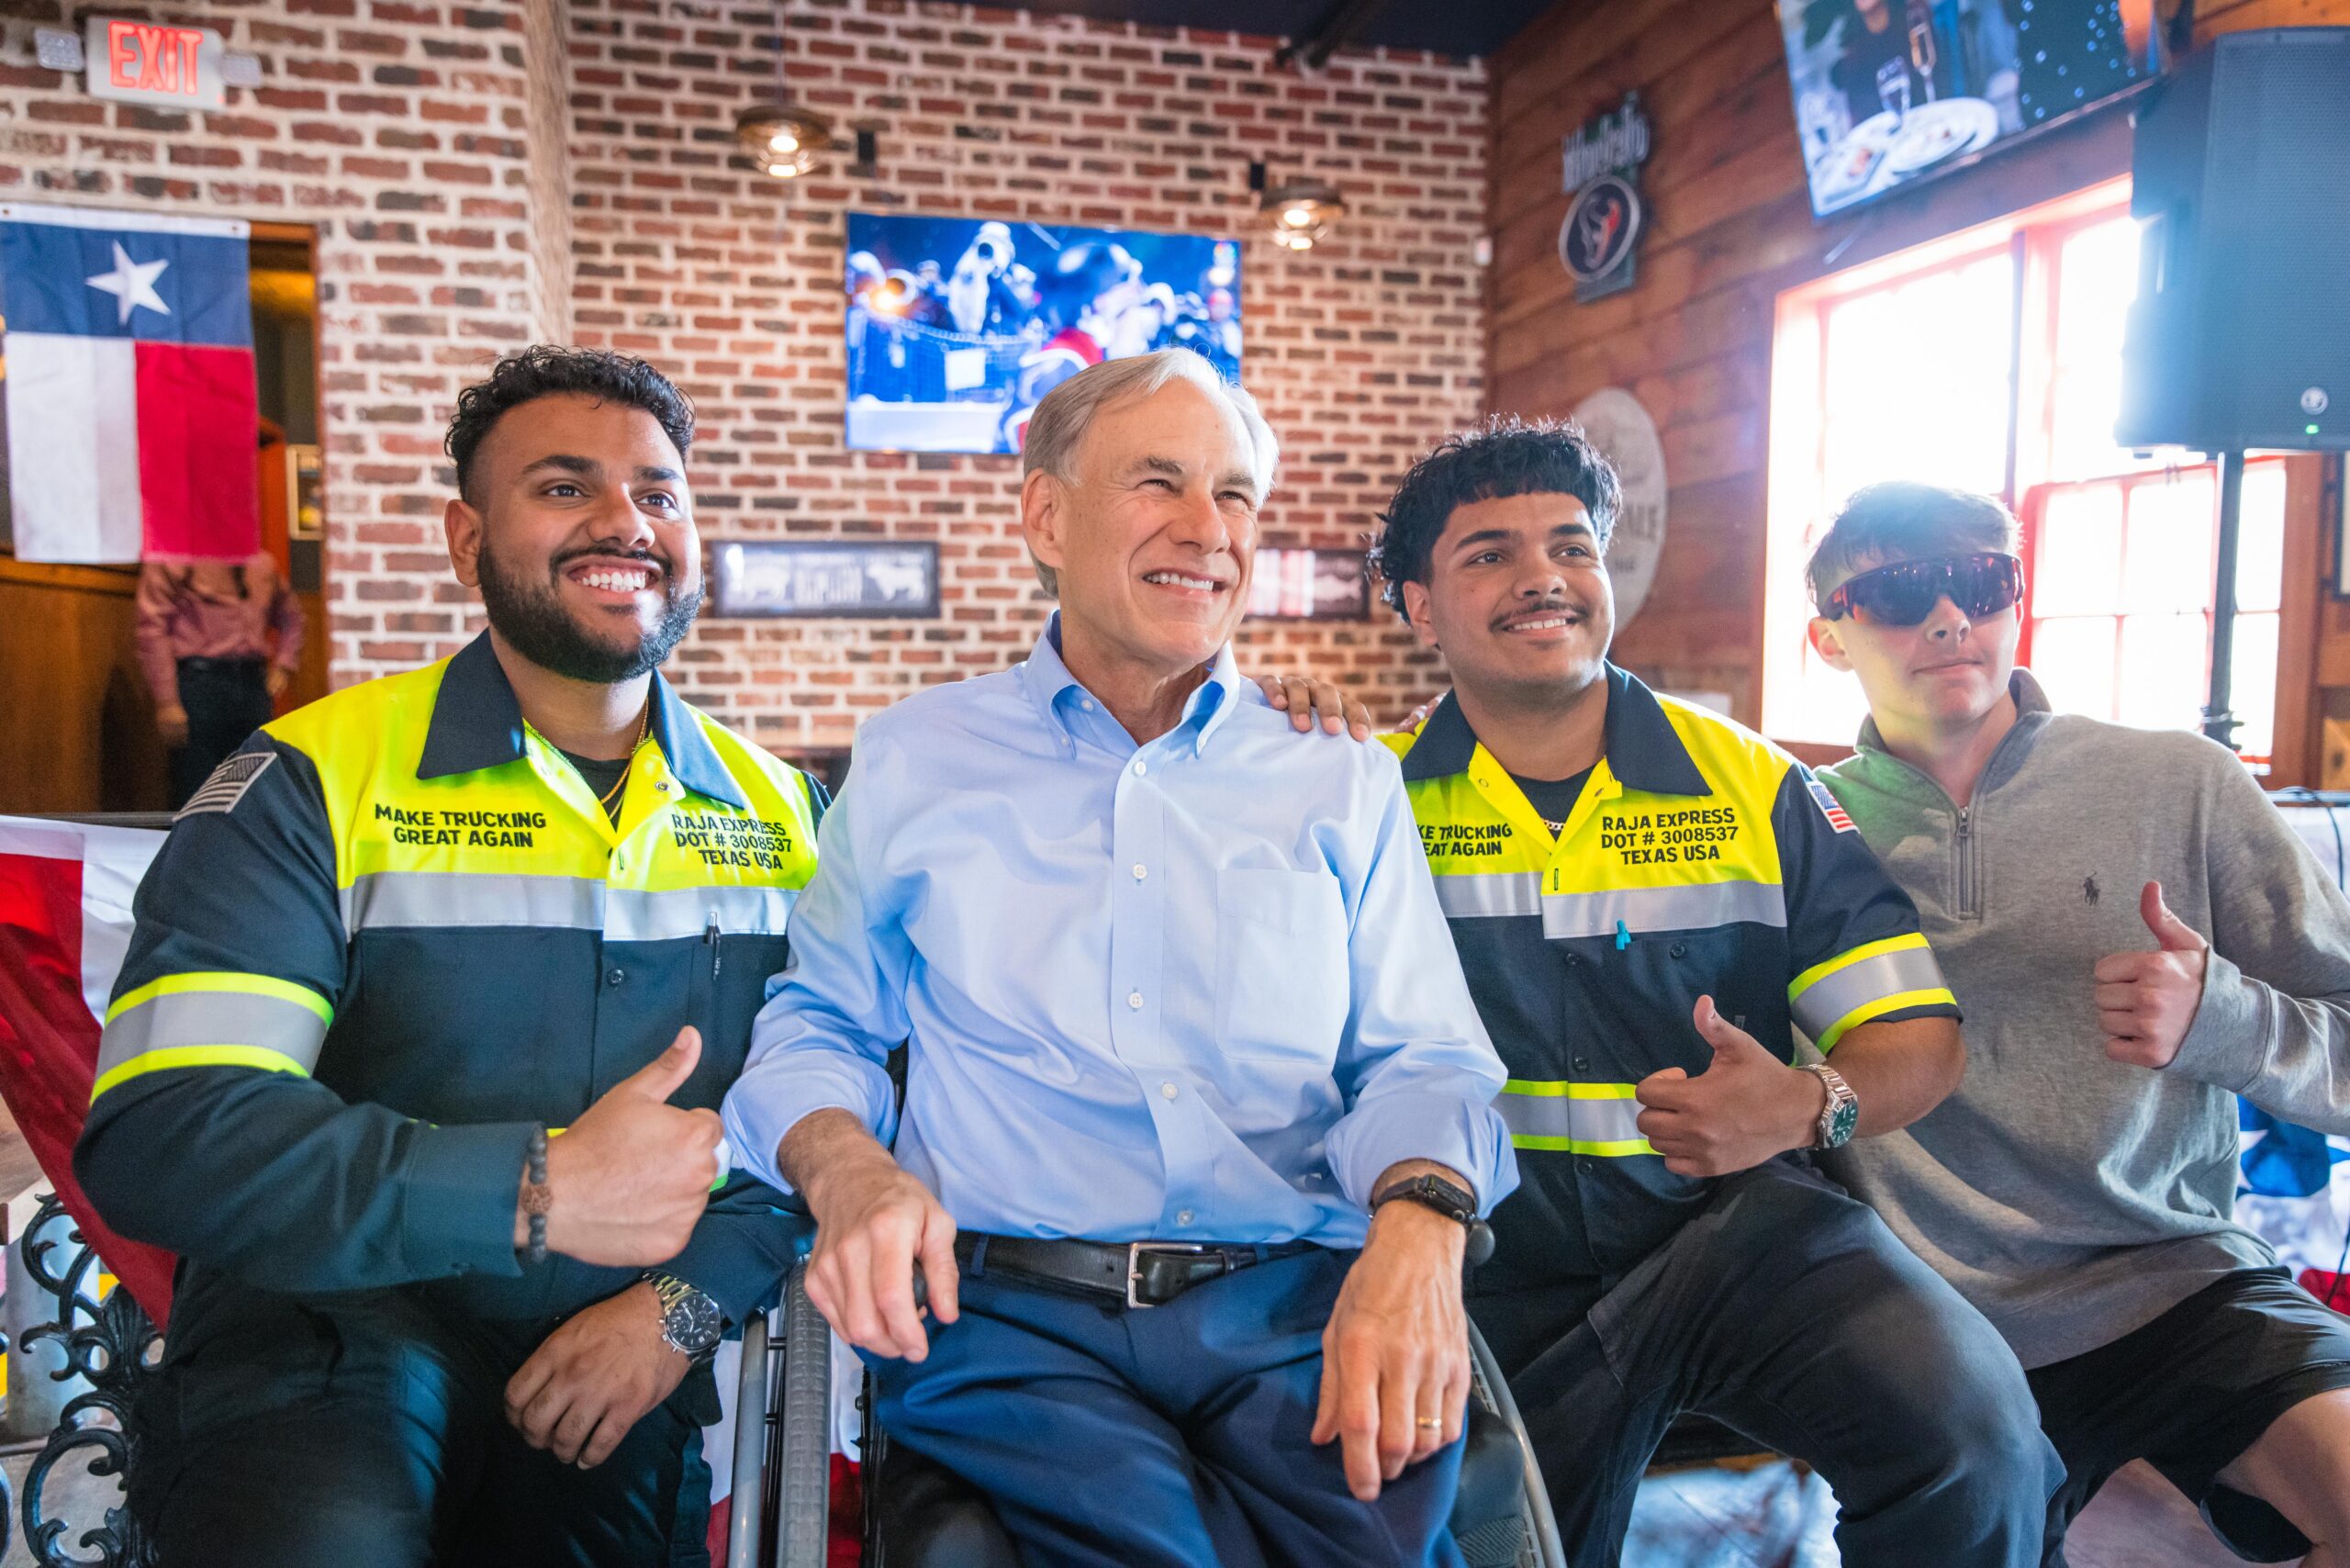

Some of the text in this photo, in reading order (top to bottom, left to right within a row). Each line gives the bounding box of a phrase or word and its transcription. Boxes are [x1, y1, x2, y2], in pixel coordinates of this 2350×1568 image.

[108, 20, 204, 95] EXIT
[375, 803, 546, 828] MAKE TRUCKING
[672, 814, 787, 835] RAJA EXPRESS
[1602, 808, 1735, 830] RAJA EXPRESS
[394, 827, 533, 847] GREAT AGAIN
[1416, 823, 1513, 840] KE TRUCKING
[1601, 826, 1739, 848] DOT # 3008537
[675, 832, 792, 852] DOT # 3008537
[1423, 841, 1502, 857] EAT AGAIN
[699, 850, 783, 869] TEXAS USA
[1621, 845, 1719, 865] TEXAS USA
